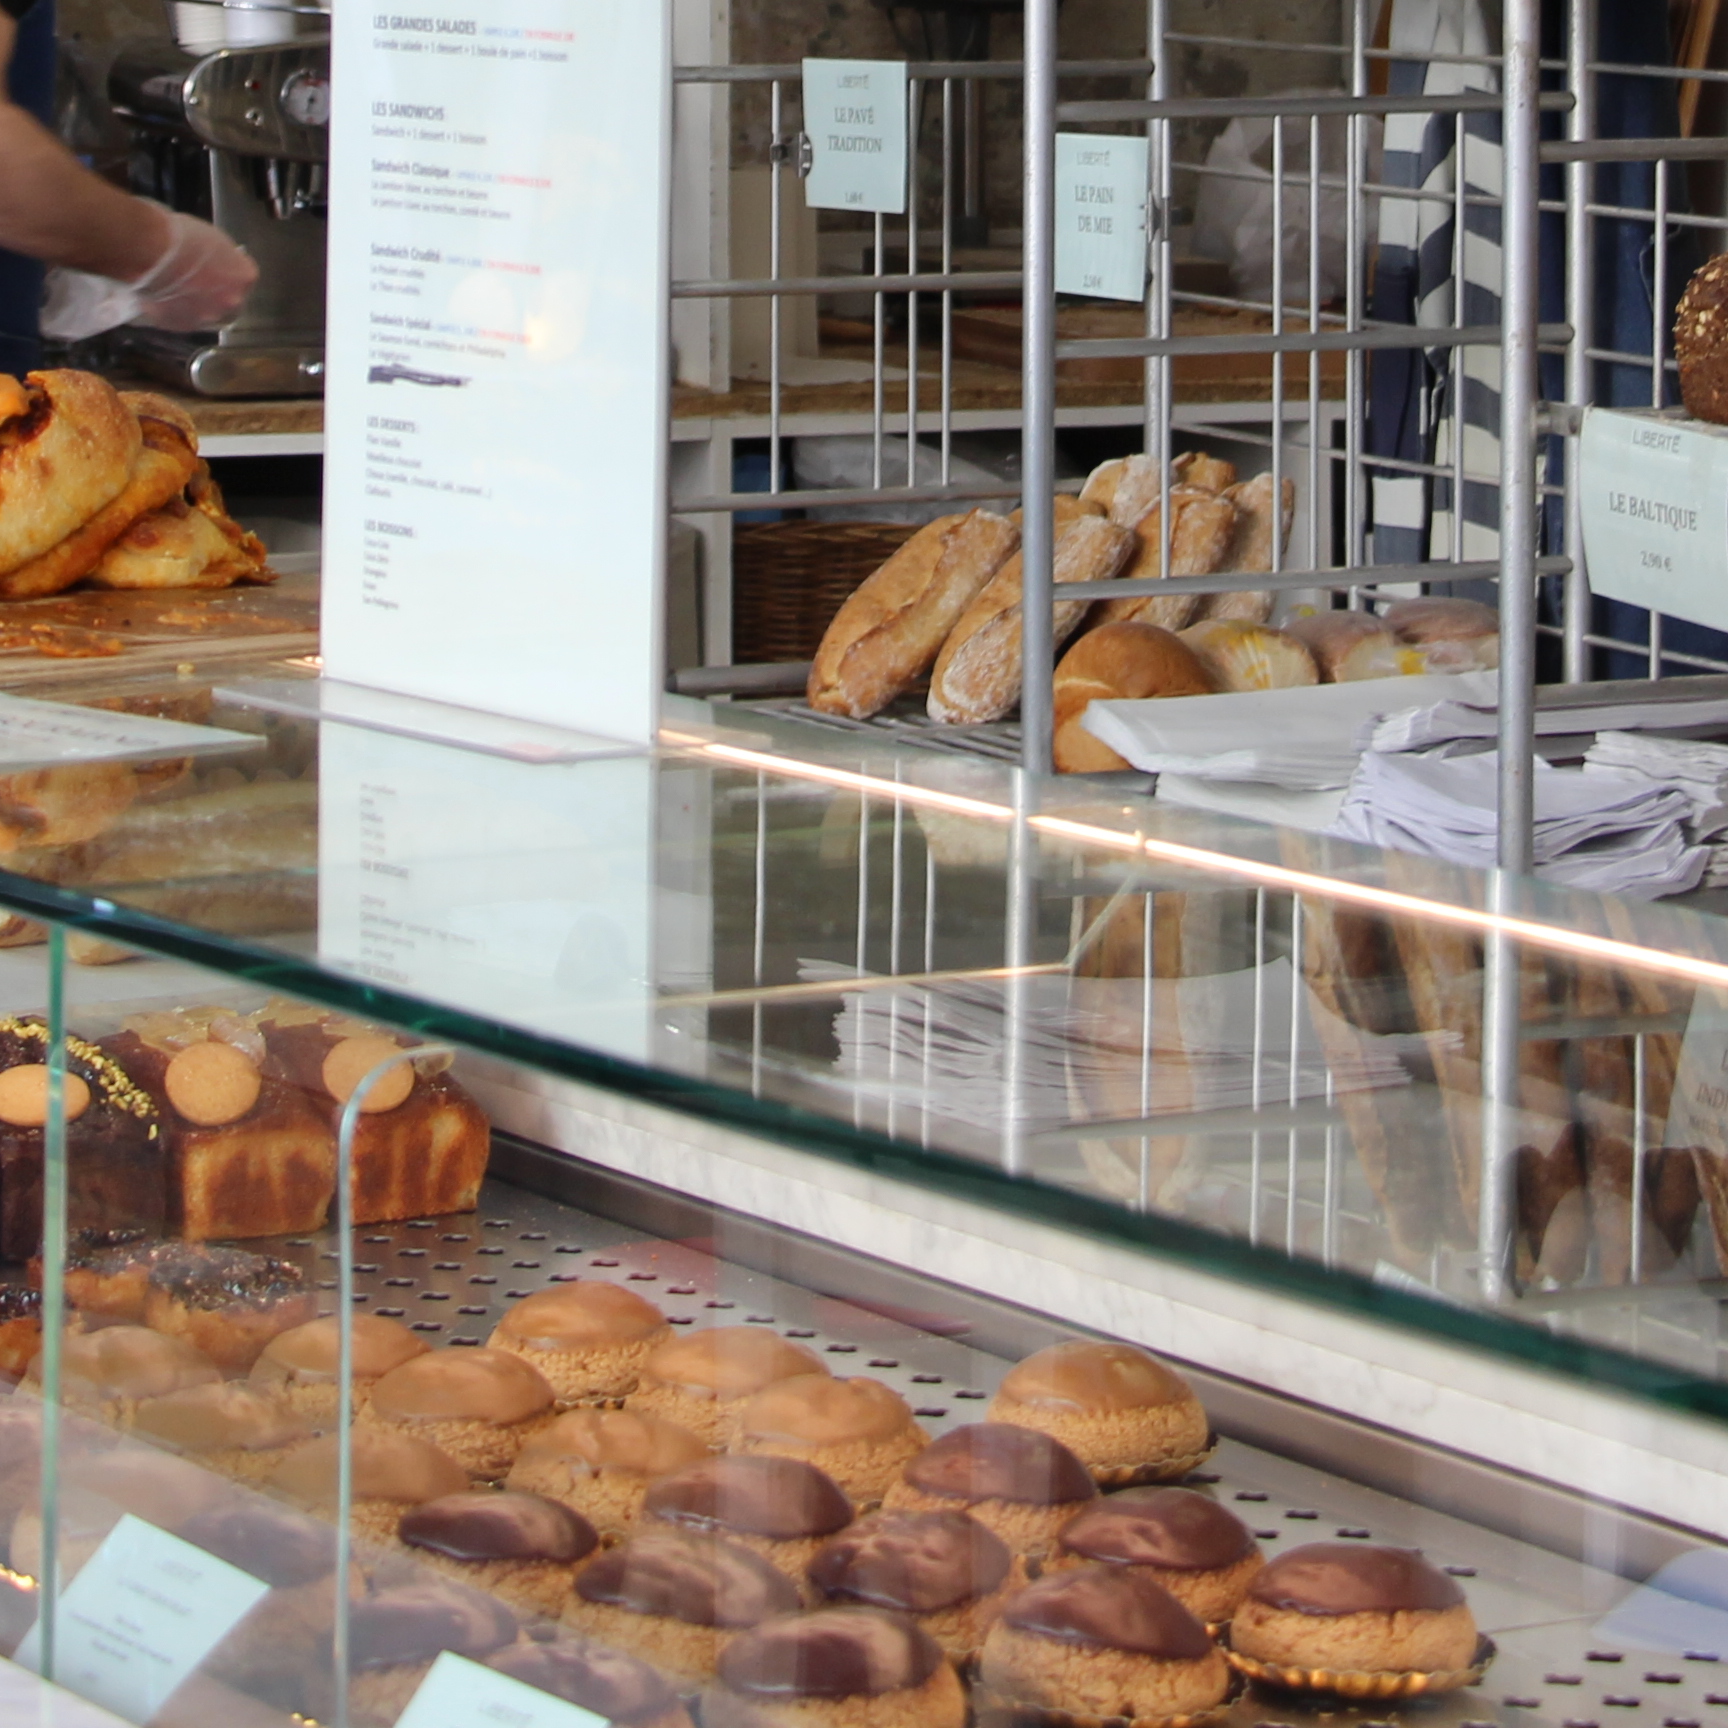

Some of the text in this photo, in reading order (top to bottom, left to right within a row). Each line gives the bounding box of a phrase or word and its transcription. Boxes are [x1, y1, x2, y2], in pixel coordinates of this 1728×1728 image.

[373, 14, 388, 30] LES
[390, 15, 434, 33] GRANDES
[436, 18, 477, 36] SALADES
[438, 42, 463, 55] dessert
[372, 102, 444, 121] LES SANDWICHS
[835, 105, 874, 125] LE PAVÉ
[827, 134, 882, 153] TRADITION
[372, 158, 450, 179] Sandwich Classique
[1075, 184, 1114, 205] LE PAIN
[1078, 215, 1113, 235] DE MIE
[371, 242, 409, 259] Sandwich
[371, 311, 404, 326] Sandwich
[1632, 429, 1681, 454] LIBERTÉ
[1609, 491, 1697, 532] LE BALTIQUE
[1664, 556, 1672, 573] €
